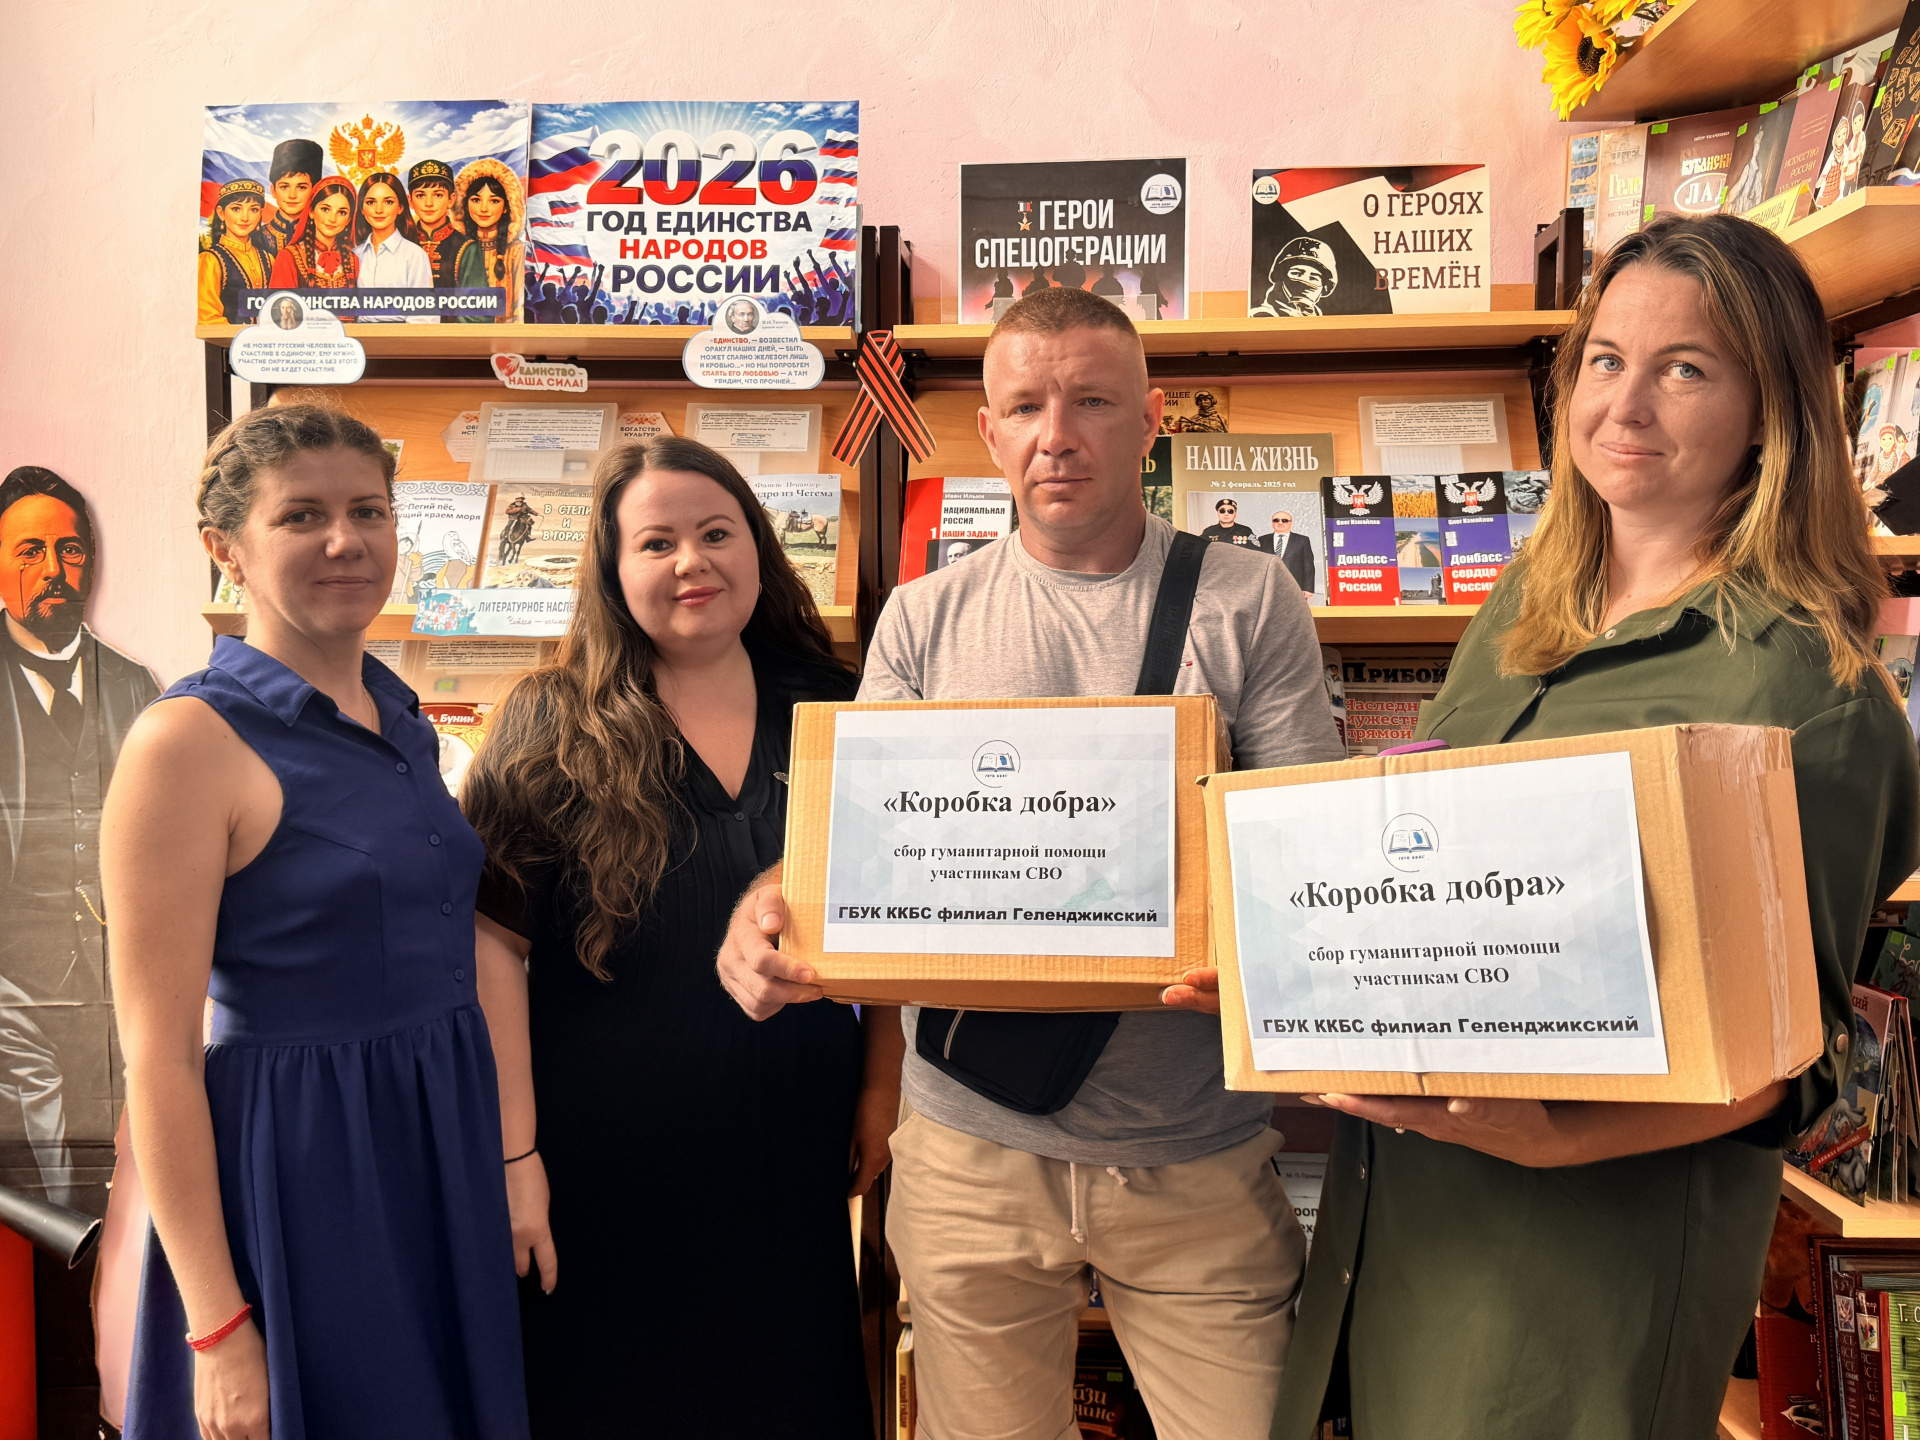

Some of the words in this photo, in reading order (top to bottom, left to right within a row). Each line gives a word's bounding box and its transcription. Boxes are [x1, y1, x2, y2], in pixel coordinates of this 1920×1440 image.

[586, 129, 818, 205] 2026
[1608, 173, 1641, 197] Геле
[1363, 193, 1379, 217] О
[1387, 191, 1484, 218] ГЕРОЯХ
[1039, 198, 1114, 231] ГЕРОИ
[586, 211, 648, 235] ГОД
[656, 211, 813, 236] ЕДИНСТВА
[1373, 229, 1474, 254] НАШИХ
[619, 238, 768, 262] НАРОДОВ
[975, 234, 1167, 270] СПЕЦОПЕРАЦИИ
[611, 264, 780, 293] РОССИИ
[1374, 261, 1481, 291] ВРЕМЁН
[247, 296, 266, 310] ГО
[302, 296, 360, 309] ИНСТВА
[363, 295, 435, 311] НАРОДОВ
[439, 295, 498, 309] РОССИИ
[519, 366, 576, 377] ЕДИНСТВО
[508, 376, 544, 387] НАША
[546, 378, 584, 388] СИЛА!
[1185, 445, 1246, 471] НАША
[1249, 446, 1319, 472] ЖИЗНЬ
[1210, 480, 1220, 488] №
[1228, 481, 1261, 489] февраль
[1283, 481, 1296, 489] год
[796, 489, 833, 498] Чегема
[437, 503, 456, 511] пёс,
[544, 504, 552, 514] В
[943, 507, 1005, 515] НАЦИОНАЛЬНАЯ
[562, 518, 571, 528] И
[942, 517, 974, 525] РОССИЯ
[542, 530, 550, 541] В
[552, 530, 587, 542] ГОРАХ
[929, 526, 937, 539] 1
[942, 530, 965, 538] НАШИ
[966, 530, 998, 538] ЗАДАЧИ
[1337, 554, 1388, 566] Донбасс
[1450, 552, 1503, 566] Донбасс
[1338, 569, 1382, 579] сердце
[1451, 567, 1497, 579] сердце
[1339, 581, 1382, 592] России
[478, 601, 544, 613] ЛИТЕРАТУРНОЕ
[546, 601, 575, 613] НАСЛЕ
[1393, 597, 1400, 606] 1
[1345, 699, 1419, 713] Наследн
[440, 713, 474, 724] Бунин
[1346, 714, 1418, 728] мужеств
[883, 790, 1012, 818] «Коробка
[1020, 790, 1117, 818] добра»
[893, 845, 927, 861] сбор
[930, 845, 1039, 861] гуманитарной
[1044, 847, 1106, 860] помощи
[930, 867, 1021, 882] участникам
[1025, 866, 1063, 881] СВО
[1289, 877, 1436, 914] «Коробка
[1446, 870, 1566, 906] добра»
[838, 906, 881, 920] ГБУК
[886, 906, 932, 921] ККБС
[937, 906, 1007, 923] филиал
[1013, 906, 1158, 924] Геленджикский
[1308, 945, 1345, 965] сбор
[1349, 941, 1477, 964] гуманитарной
[1482, 940, 1561, 960] помощи
[1353, 969, 1459, 989] участникам
[1464, 967, 1510, 985] СВО
[1263, 1018, 1309, 1034] ГБУК
[1314, 1018, 1365, 1034] ККБС
[1370, 1017, 1452, 1037] филиал
[1458, 1016, 1639, 1036] Геленджикский
